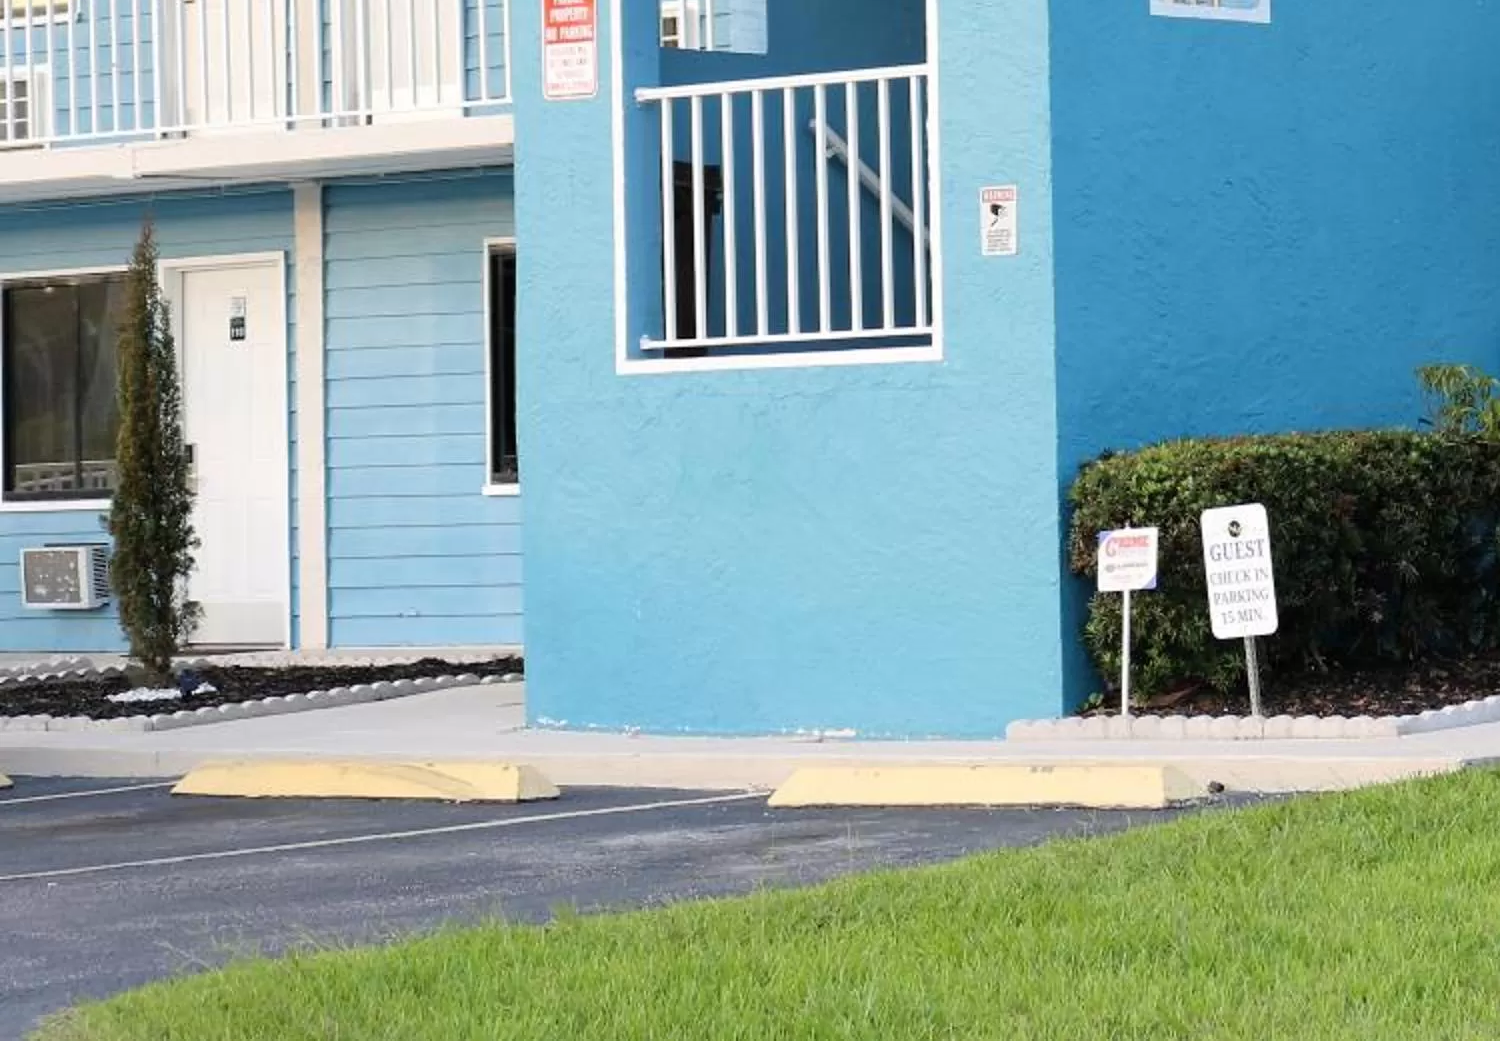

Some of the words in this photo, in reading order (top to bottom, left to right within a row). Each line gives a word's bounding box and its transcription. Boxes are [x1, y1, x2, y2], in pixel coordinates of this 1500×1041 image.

[1209, 538, 1265, 562] GUEST
[1209, 569, 1251, 586] CHECK
[1253, 566, 1269, 582] IN
[1213, 588, 1270, 606] PARKING
[1221, 610, 1236, 626] 15
